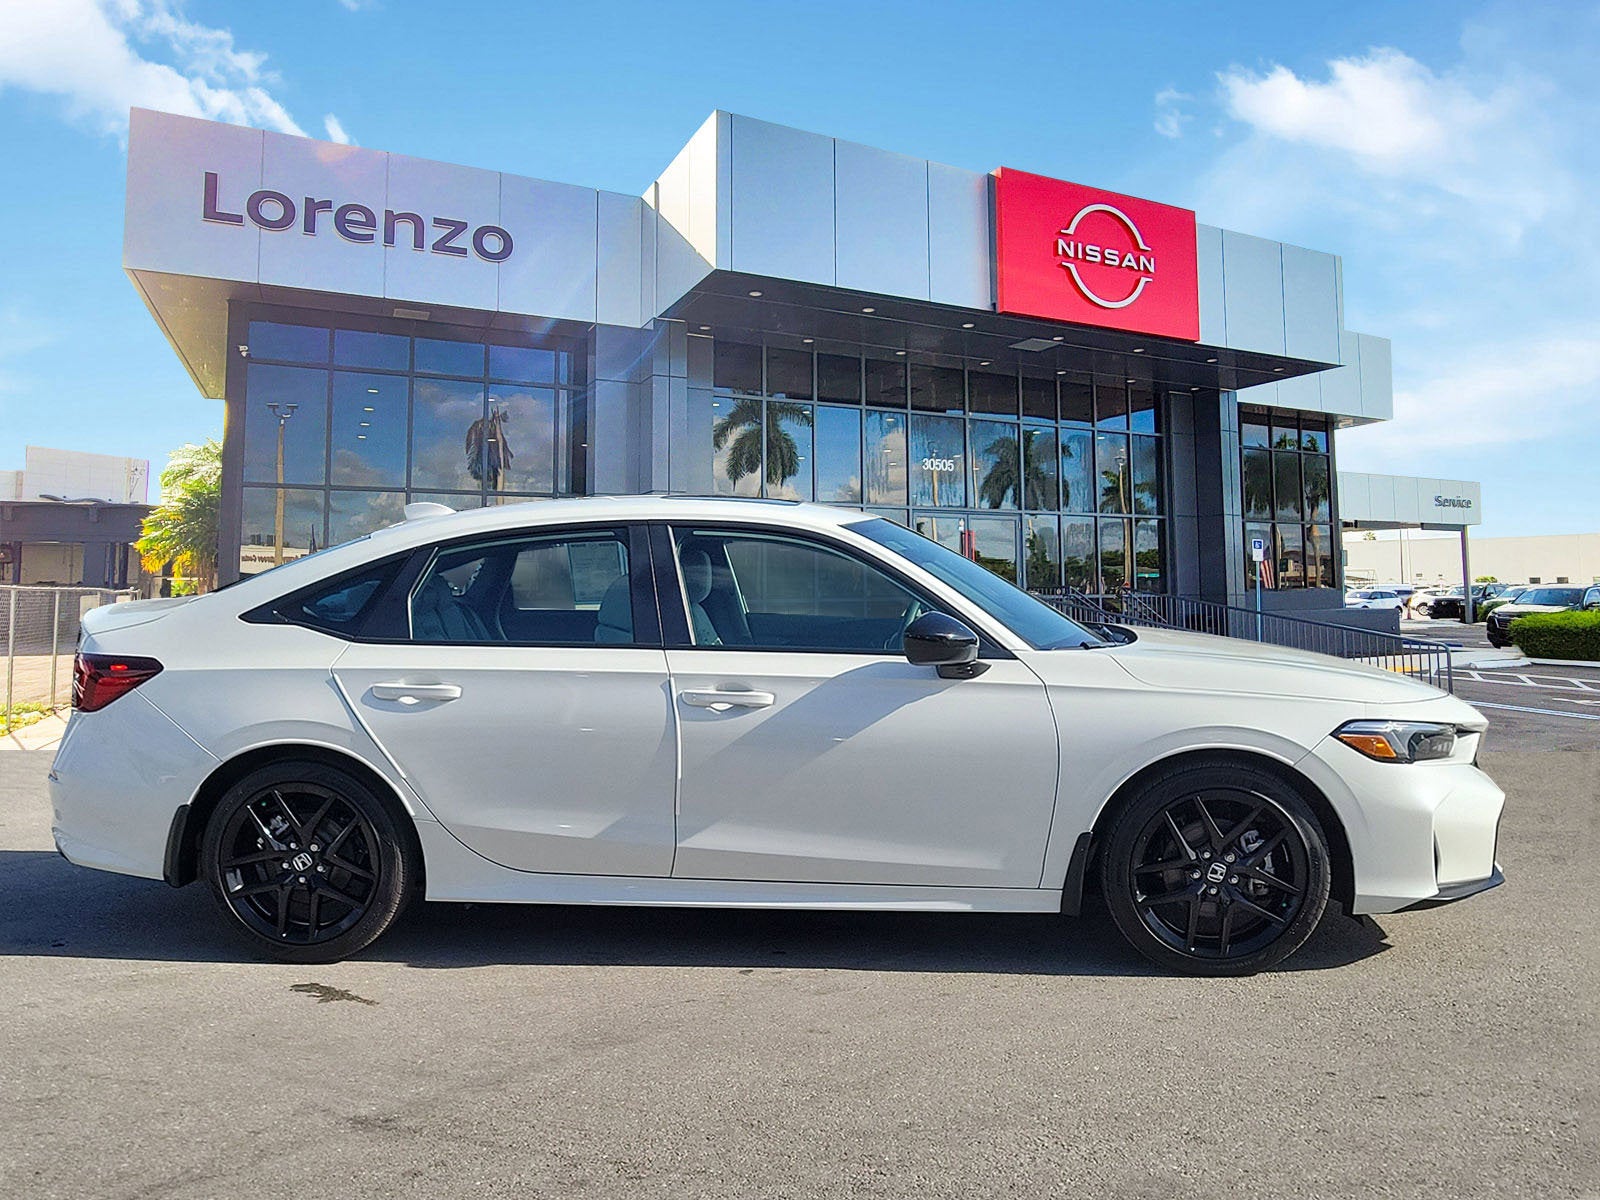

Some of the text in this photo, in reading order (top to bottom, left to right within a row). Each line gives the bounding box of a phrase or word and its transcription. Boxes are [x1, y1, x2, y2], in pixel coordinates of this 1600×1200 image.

[203, 171, 514, 262] Lorenzo
[1057, 238, 1155, 273] NISSAN
[922, 458, 954, 471] 30505
[1434, 495, 1472, 508] Service
